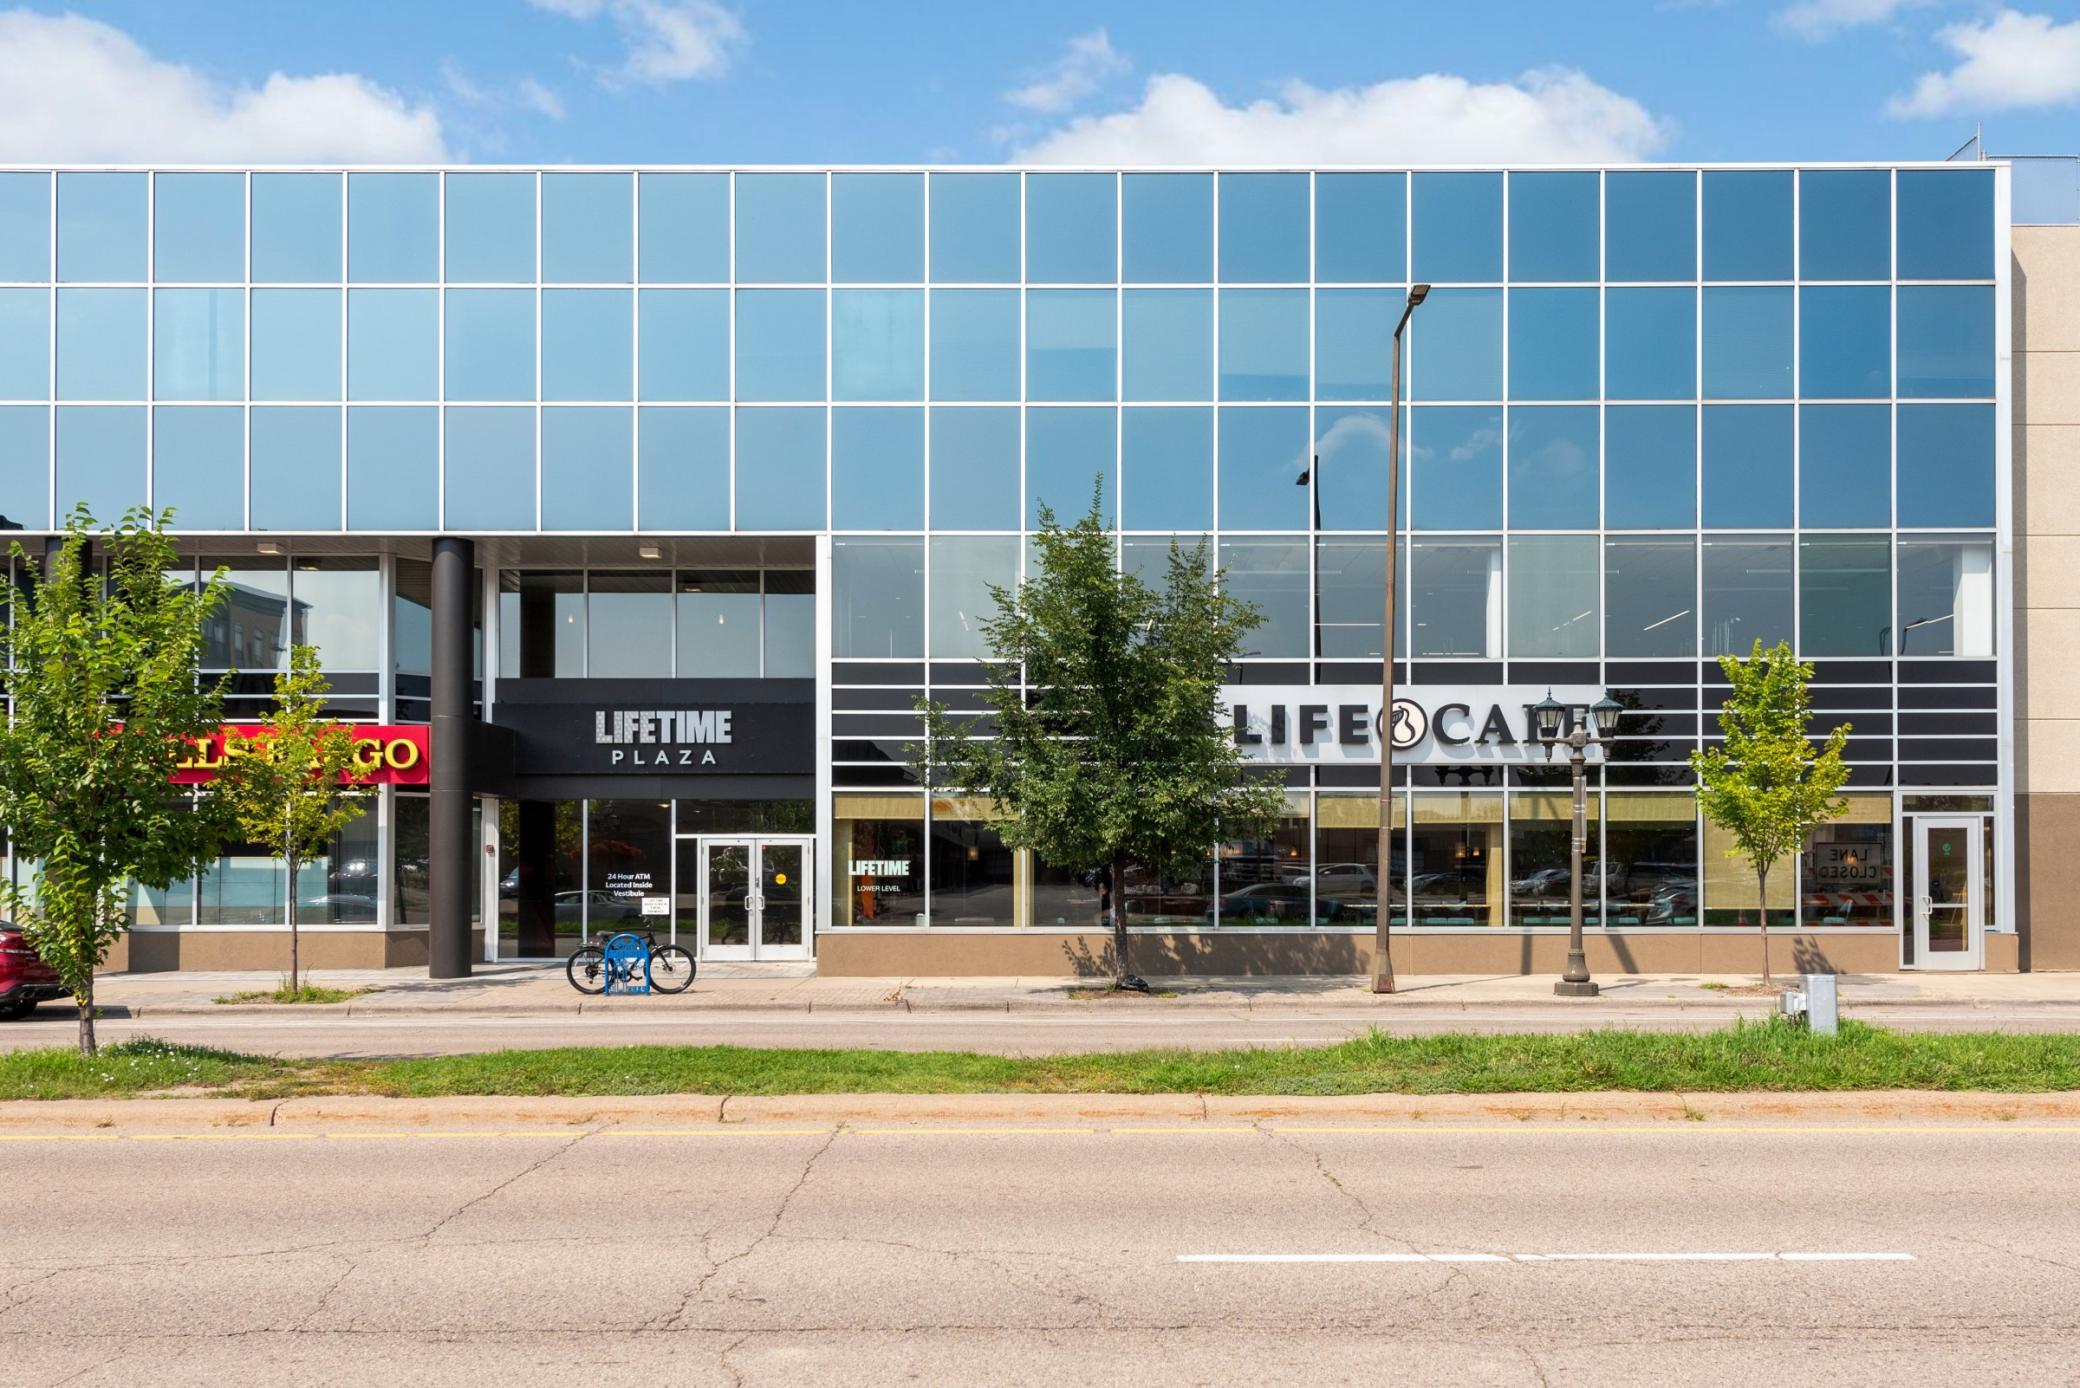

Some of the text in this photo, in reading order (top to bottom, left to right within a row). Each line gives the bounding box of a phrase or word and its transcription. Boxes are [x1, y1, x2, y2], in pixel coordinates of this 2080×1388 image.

[595, 710, 732, 744] LIFETIME
[1234, 704, 1369, 744] LIFE
[612, 750, 717, 765] PLAZA
[848, 860, 911, 876] LIFETIME
